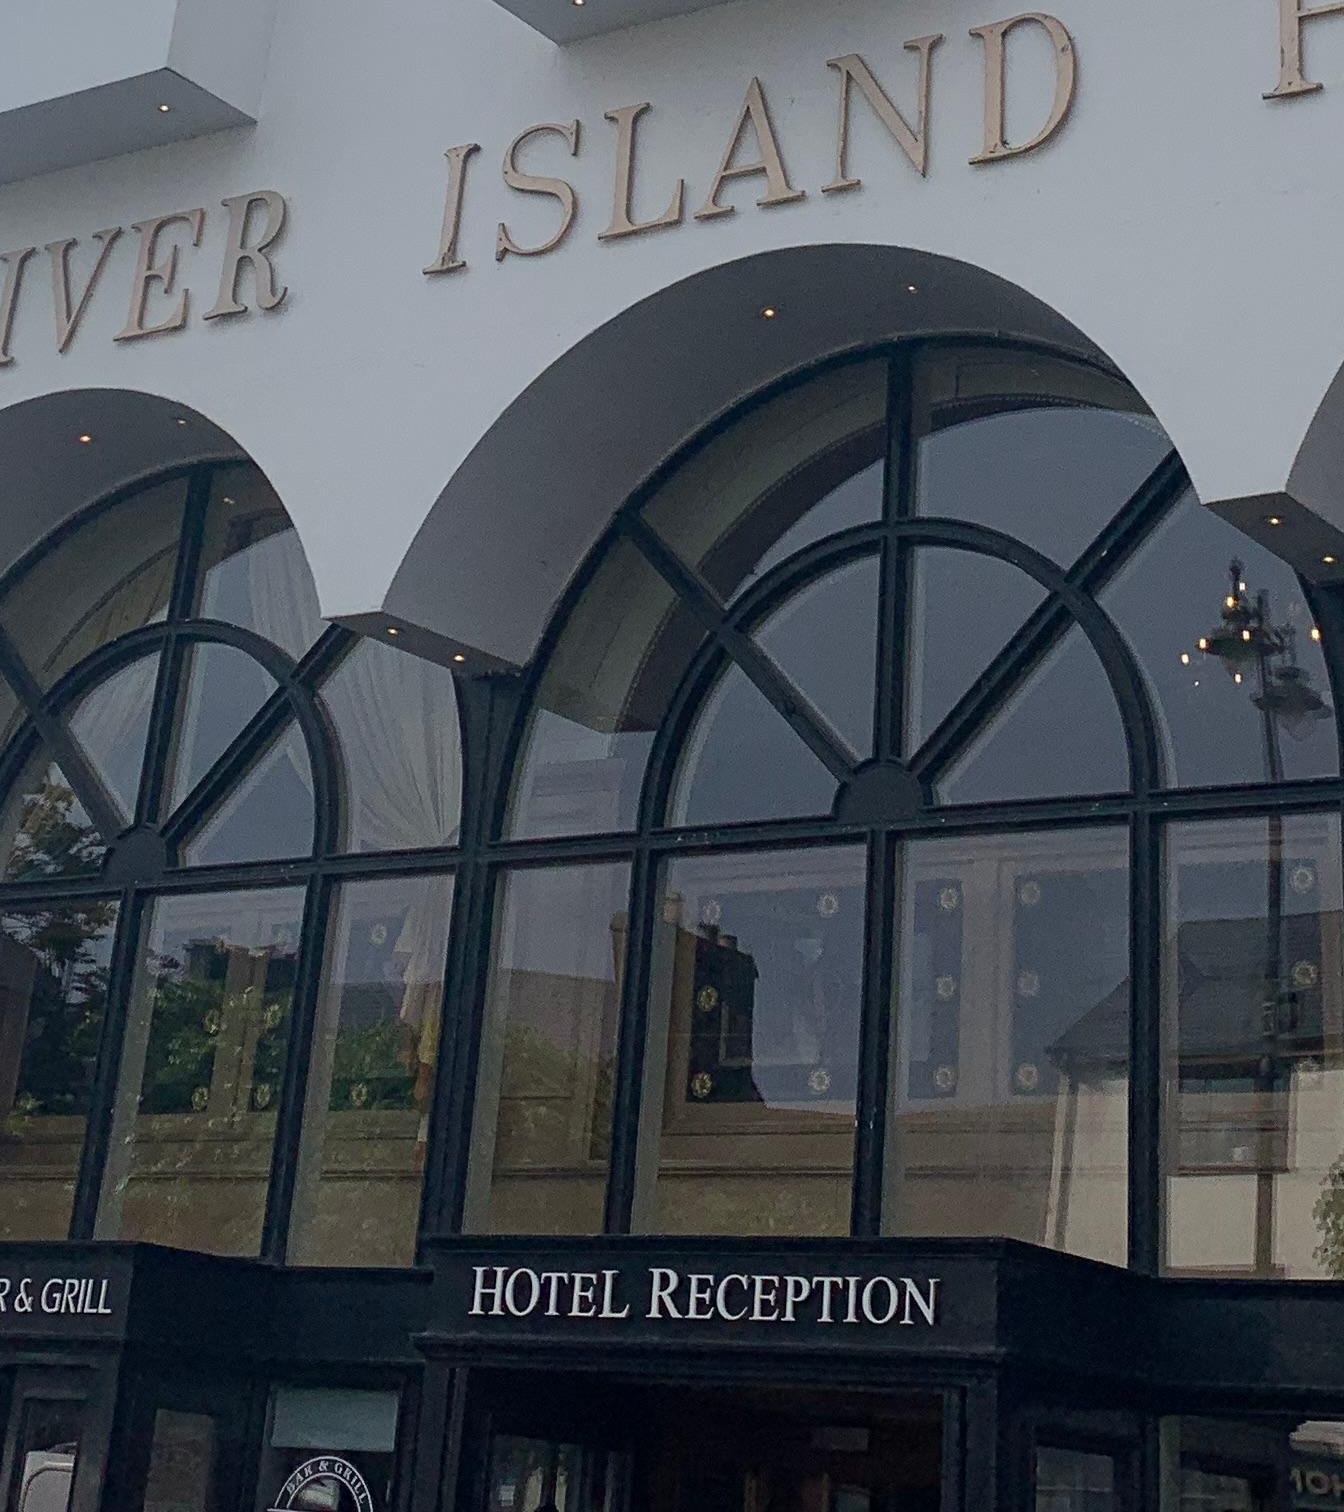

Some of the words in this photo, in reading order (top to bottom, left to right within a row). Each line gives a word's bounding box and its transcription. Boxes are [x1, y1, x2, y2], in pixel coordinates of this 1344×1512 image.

[422, 12, 1078, 275] ISLAND
[14, 1278, 34, 1313] &
[41, 1278, 112, 1314] GRILL
[468, 1266, 630, 1318] HOTEL
[645, 1268, 941, 1326] RECEPTION
[286, 1465, 313, 1494] BAR
[318, 1460, 329, 1472] &
[334, 1462, 368, 1505] GRILL
